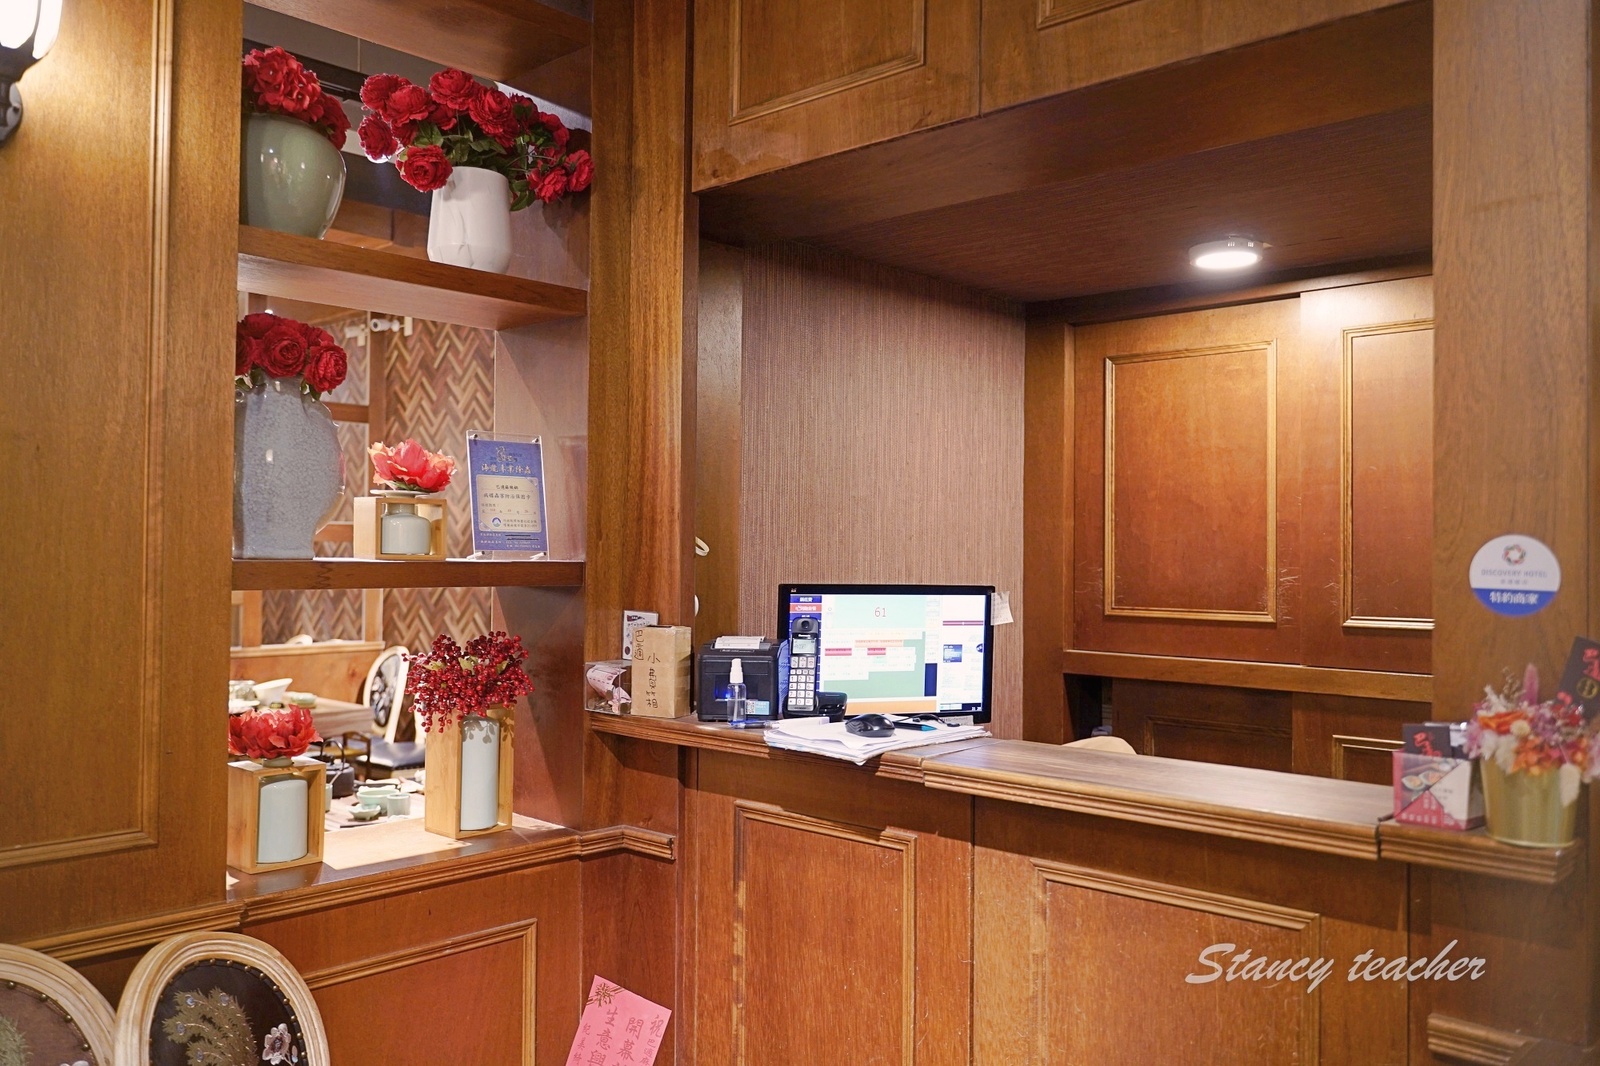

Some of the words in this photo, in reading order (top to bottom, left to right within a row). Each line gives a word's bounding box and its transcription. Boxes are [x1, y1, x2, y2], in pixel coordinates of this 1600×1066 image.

[1481, 568, 1521, 577] DISCOVERY
[1523, 570, 1549, 579] HOTEL
[1489, 591, 1540, 605] 特約商家
[874, 606, 888, 618] 61
